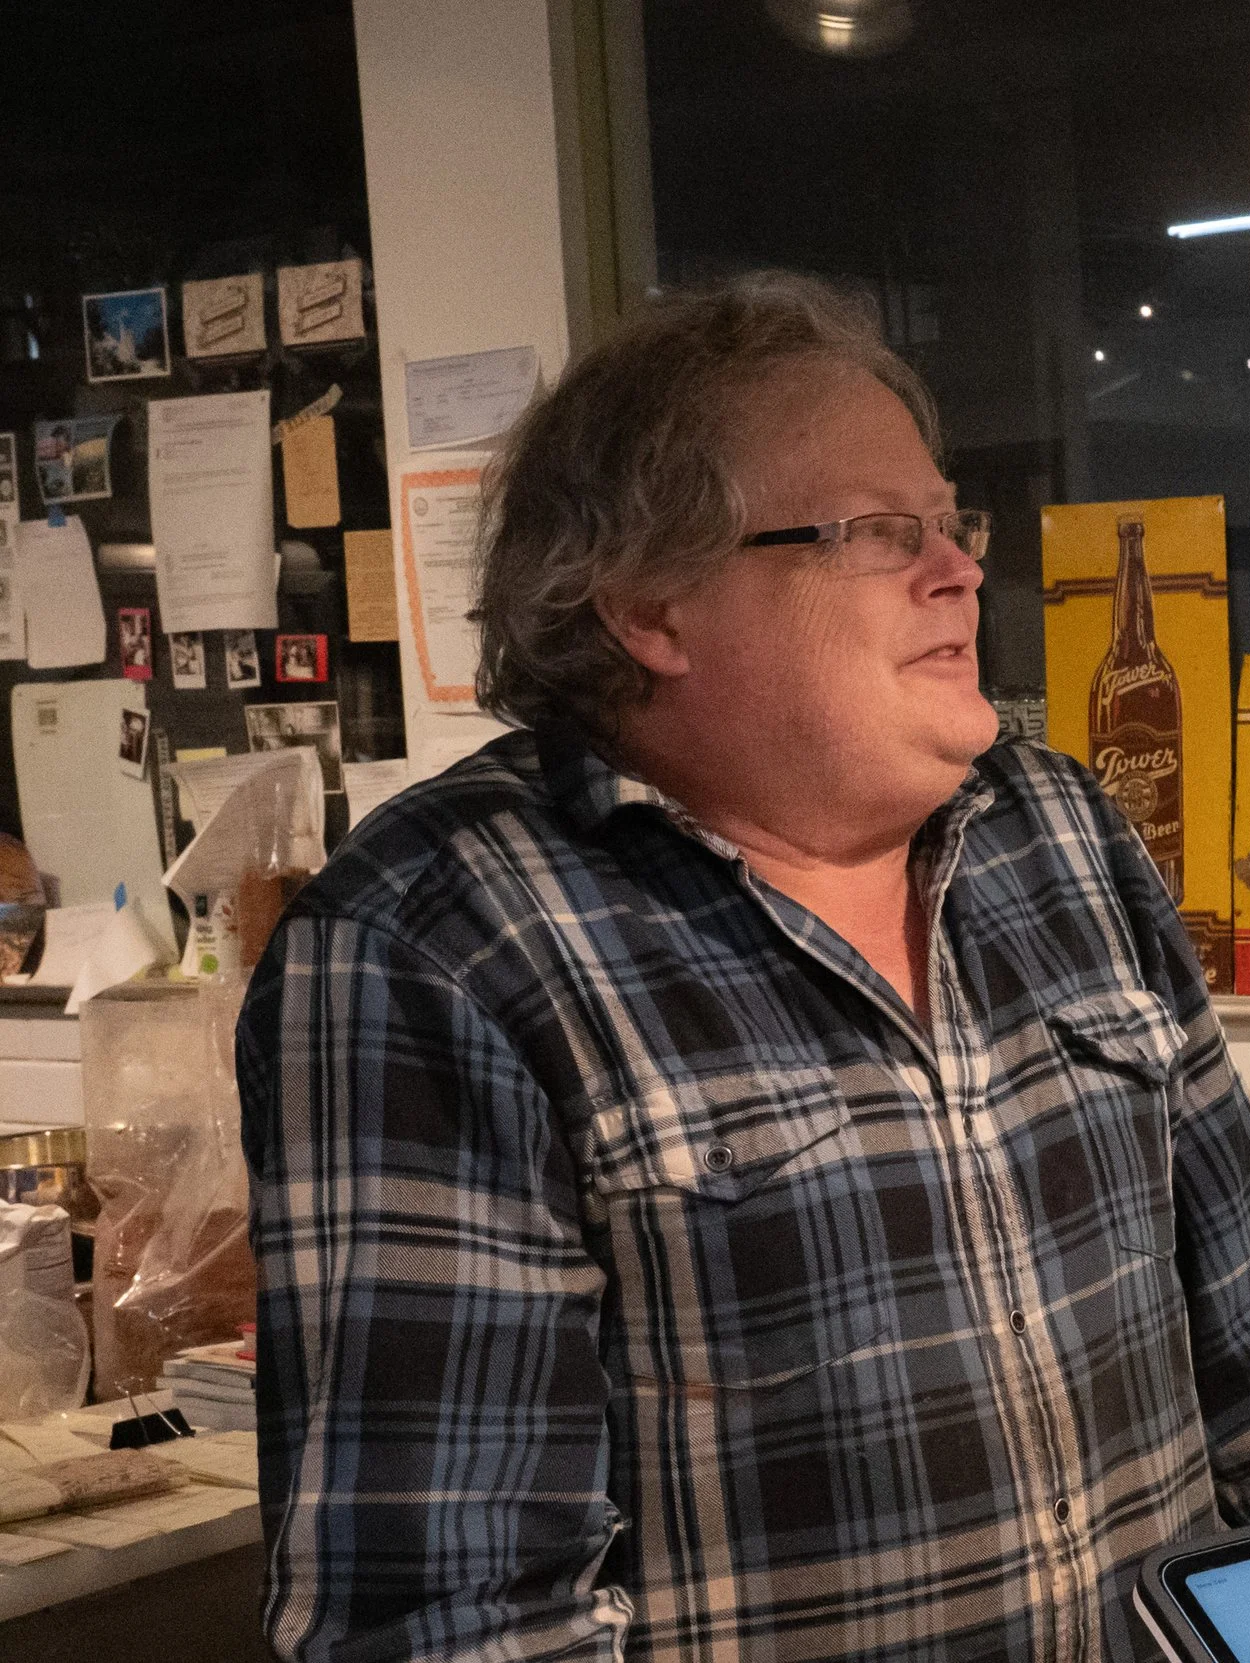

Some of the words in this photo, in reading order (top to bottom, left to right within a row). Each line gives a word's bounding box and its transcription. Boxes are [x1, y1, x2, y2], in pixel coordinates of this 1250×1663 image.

[1101, 661, 1168, 705] Tower
[1096, 746, 1178, 795] Tower
[1142, 820, 1180, 841] Beer
